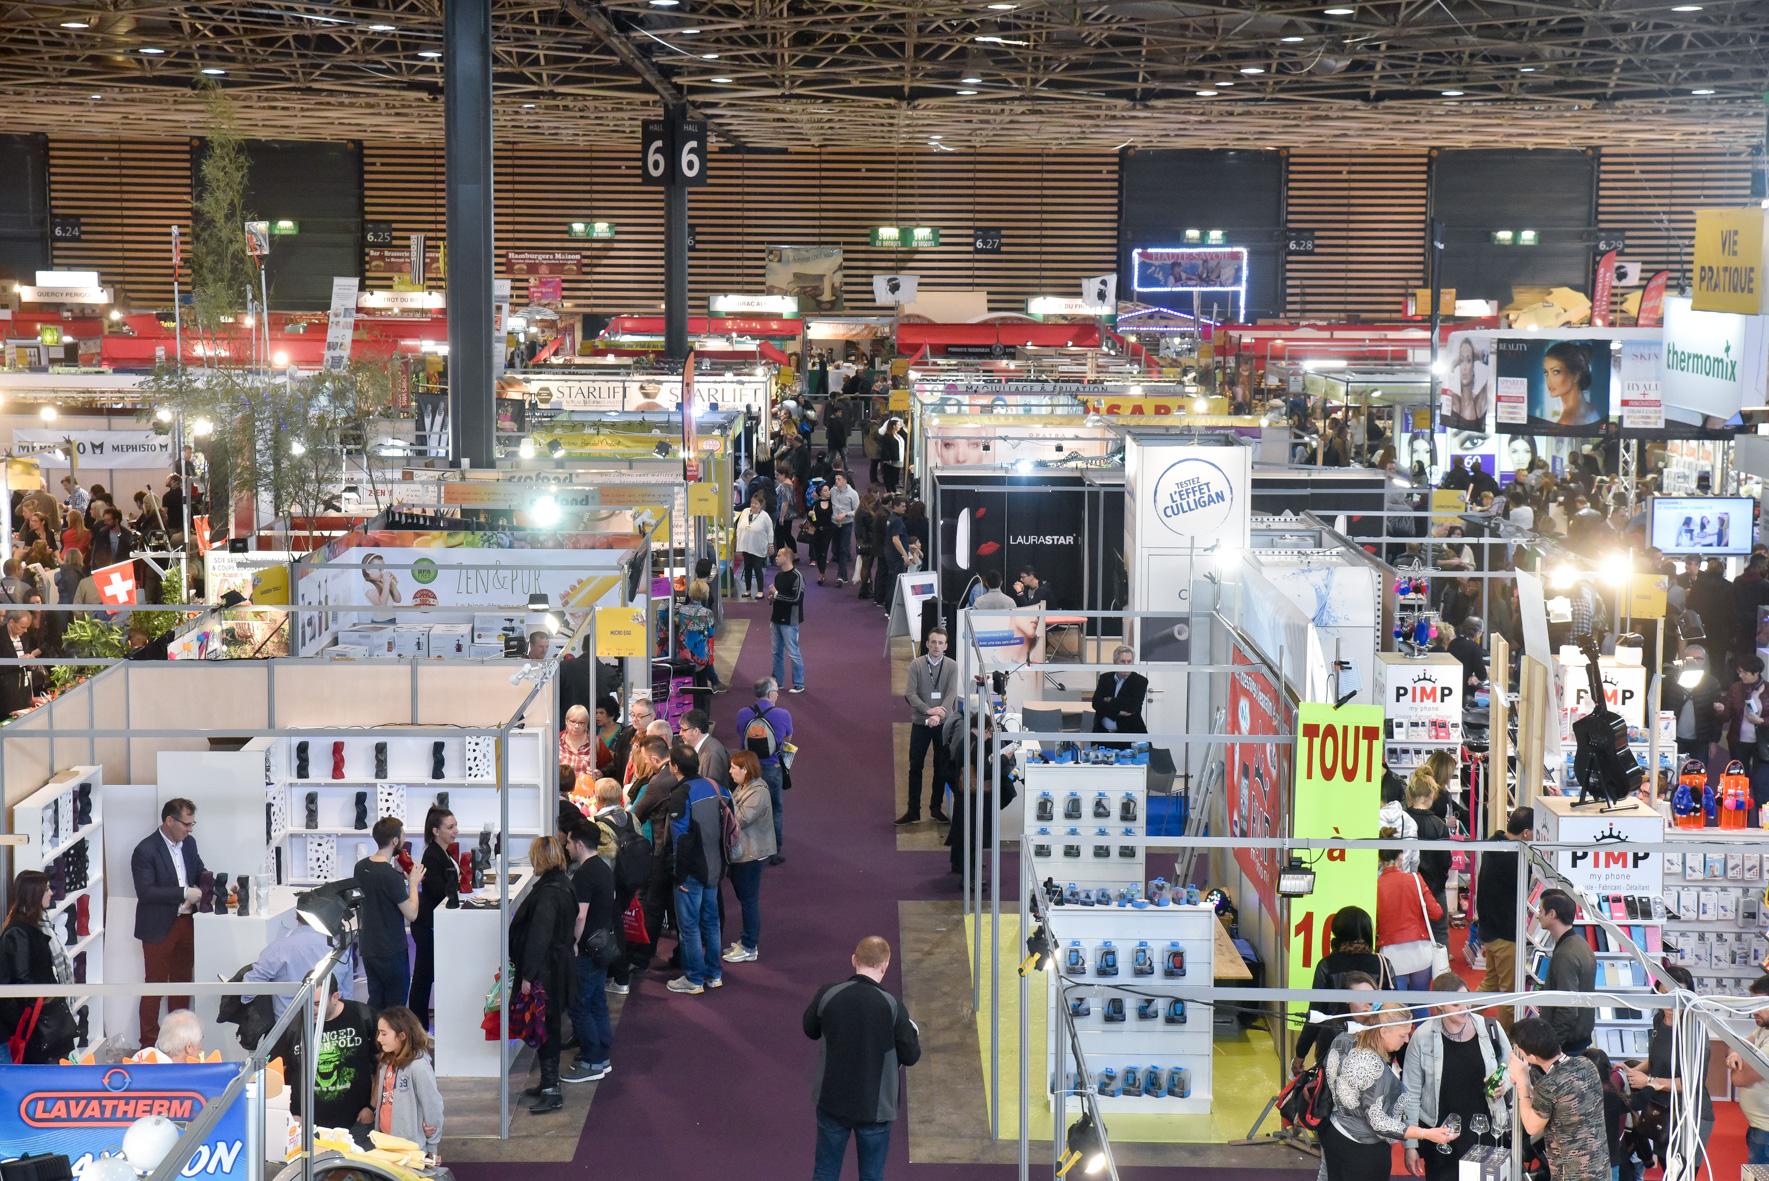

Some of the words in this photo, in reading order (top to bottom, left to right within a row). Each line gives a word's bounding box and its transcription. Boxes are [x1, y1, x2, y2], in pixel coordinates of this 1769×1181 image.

[684, 124, 698, 132] HALL
[647, 140, 665, 177] 6
[681, 140, 700, 177] 6
[55, 226, 80, 237] 6.24
[367, 232, 391, 242] 6.25
[976, 238, 999, 249] 6.27
[1289, 240, 1313, 250] 6.28
[1599, 240, 1624, 250] 6.29
[1720, 229, 1739, 257] VIE
[508, 252, 554, 260] Hamburgers
[1699, 265, 1755, 295] PRATIQUE
[1666, 340, 1738, 382] thermomix
[557, 386, 631, 400] STARLIFT
[669, 387, 762, 402] SARLIFT
[112, 443, 157, 453] MEPHISTO
[1175, 477, 1201, 490] TESTEZ
[1169, 481, 1211, 504] L'EFFET
[1163, 490, 1226, 519] CULLIGAN
[1009, 535, 1074, 545] LAURASTAR
[1395, 686, 1453, 703] PIMP
[1576, 688, 1635, 705] PMP
[1302, 723, 1380, 783] TOUT
[1571, 850, 1650, 869] PIMP
[1589, 873, 1601, 882] my
[1605, 872, 1631, 882] phone
[35, 1100, 193, 1119] LAVATHERM
